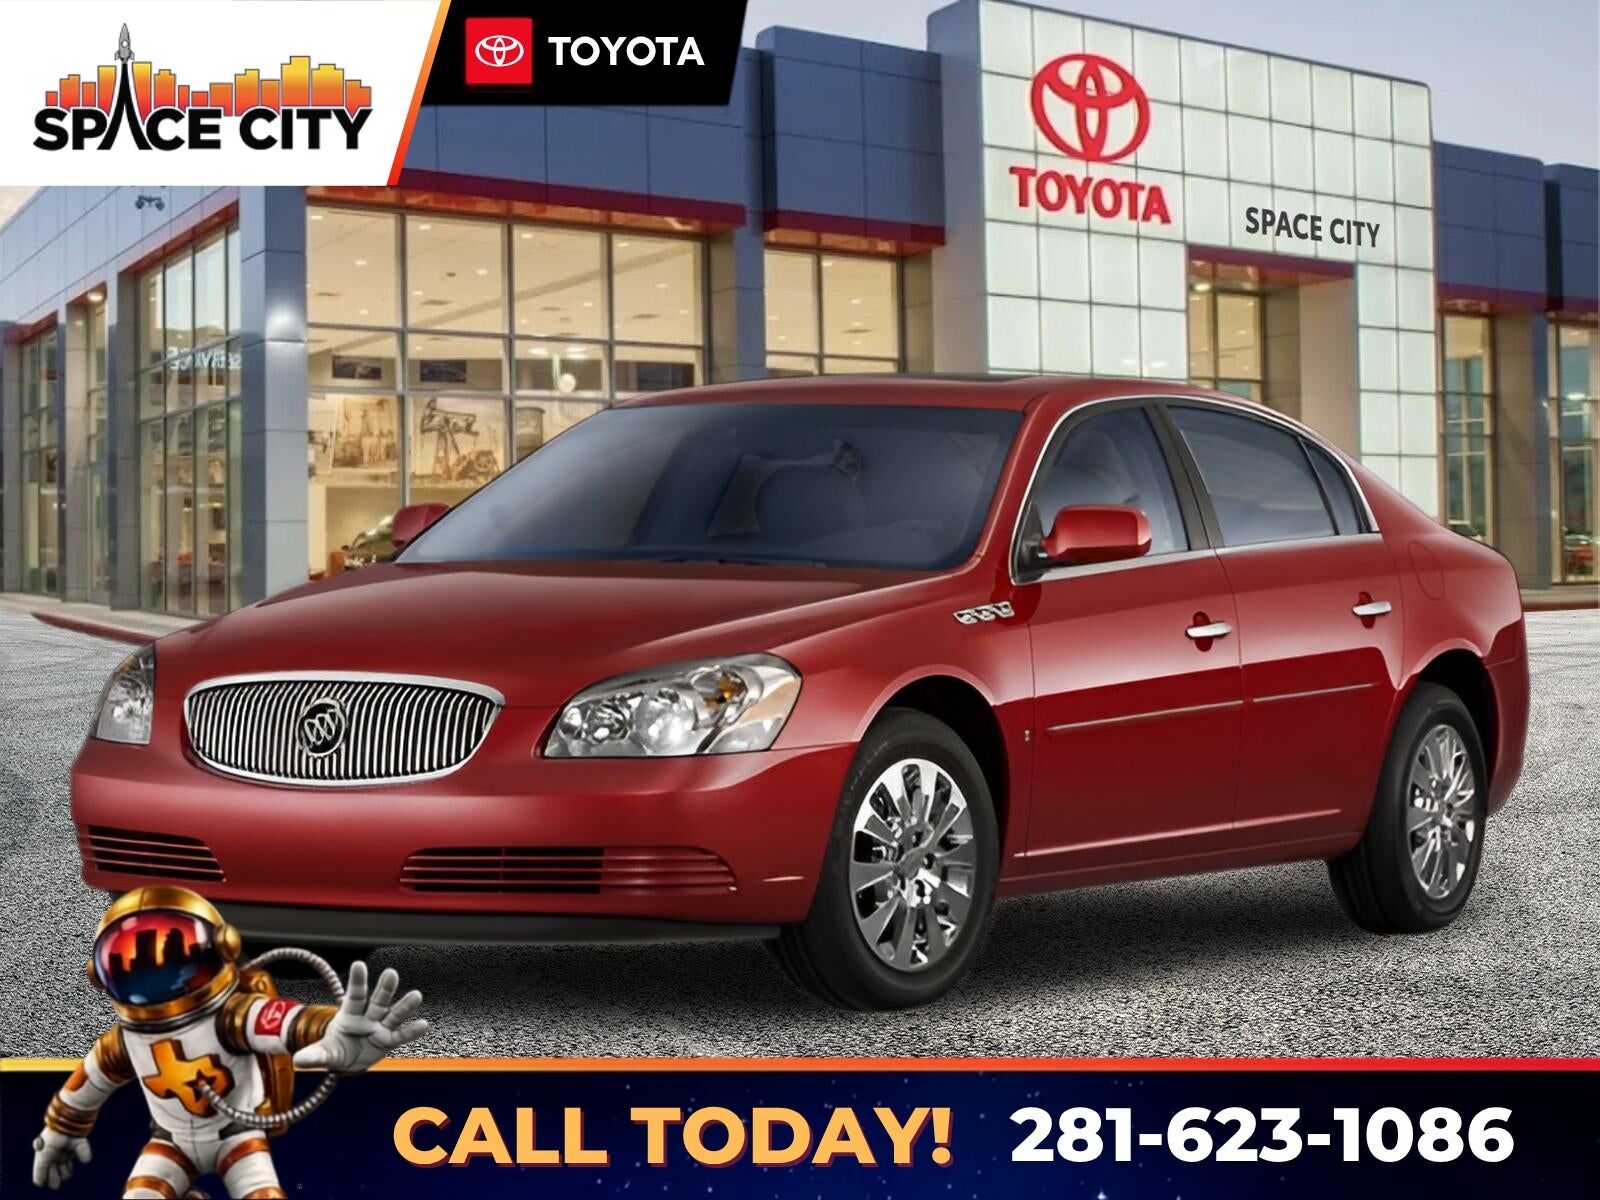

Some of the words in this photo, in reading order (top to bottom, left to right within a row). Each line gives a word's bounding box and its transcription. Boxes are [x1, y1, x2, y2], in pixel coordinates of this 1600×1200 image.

[1008, 166, 1171, 225] TOYOTA
[1245, 206, 1322, 242] SPACE
[1329, 217, 1381, 248] CITY
